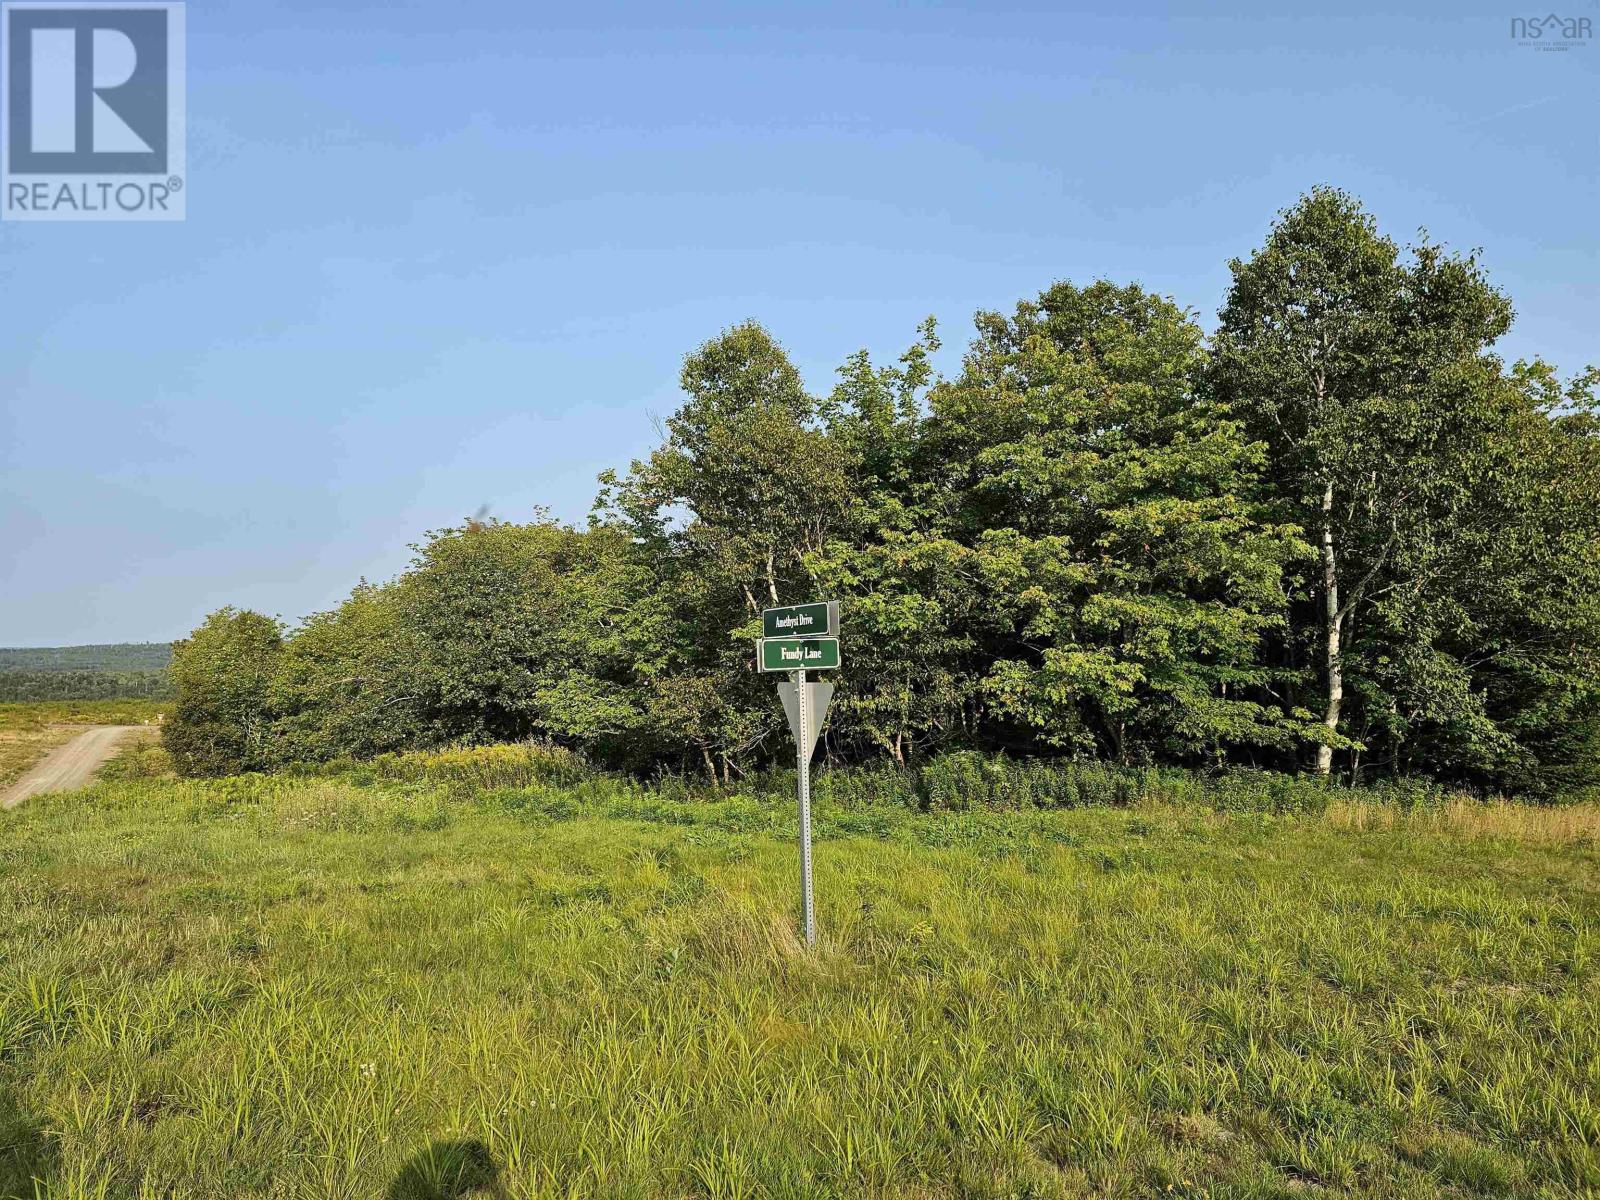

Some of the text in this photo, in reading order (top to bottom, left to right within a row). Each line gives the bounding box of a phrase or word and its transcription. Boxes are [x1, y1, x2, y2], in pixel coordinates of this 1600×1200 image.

[775, 613, 813, 628] Amethyst Drive
[781, 646, 822, 660] Fundy Lane
